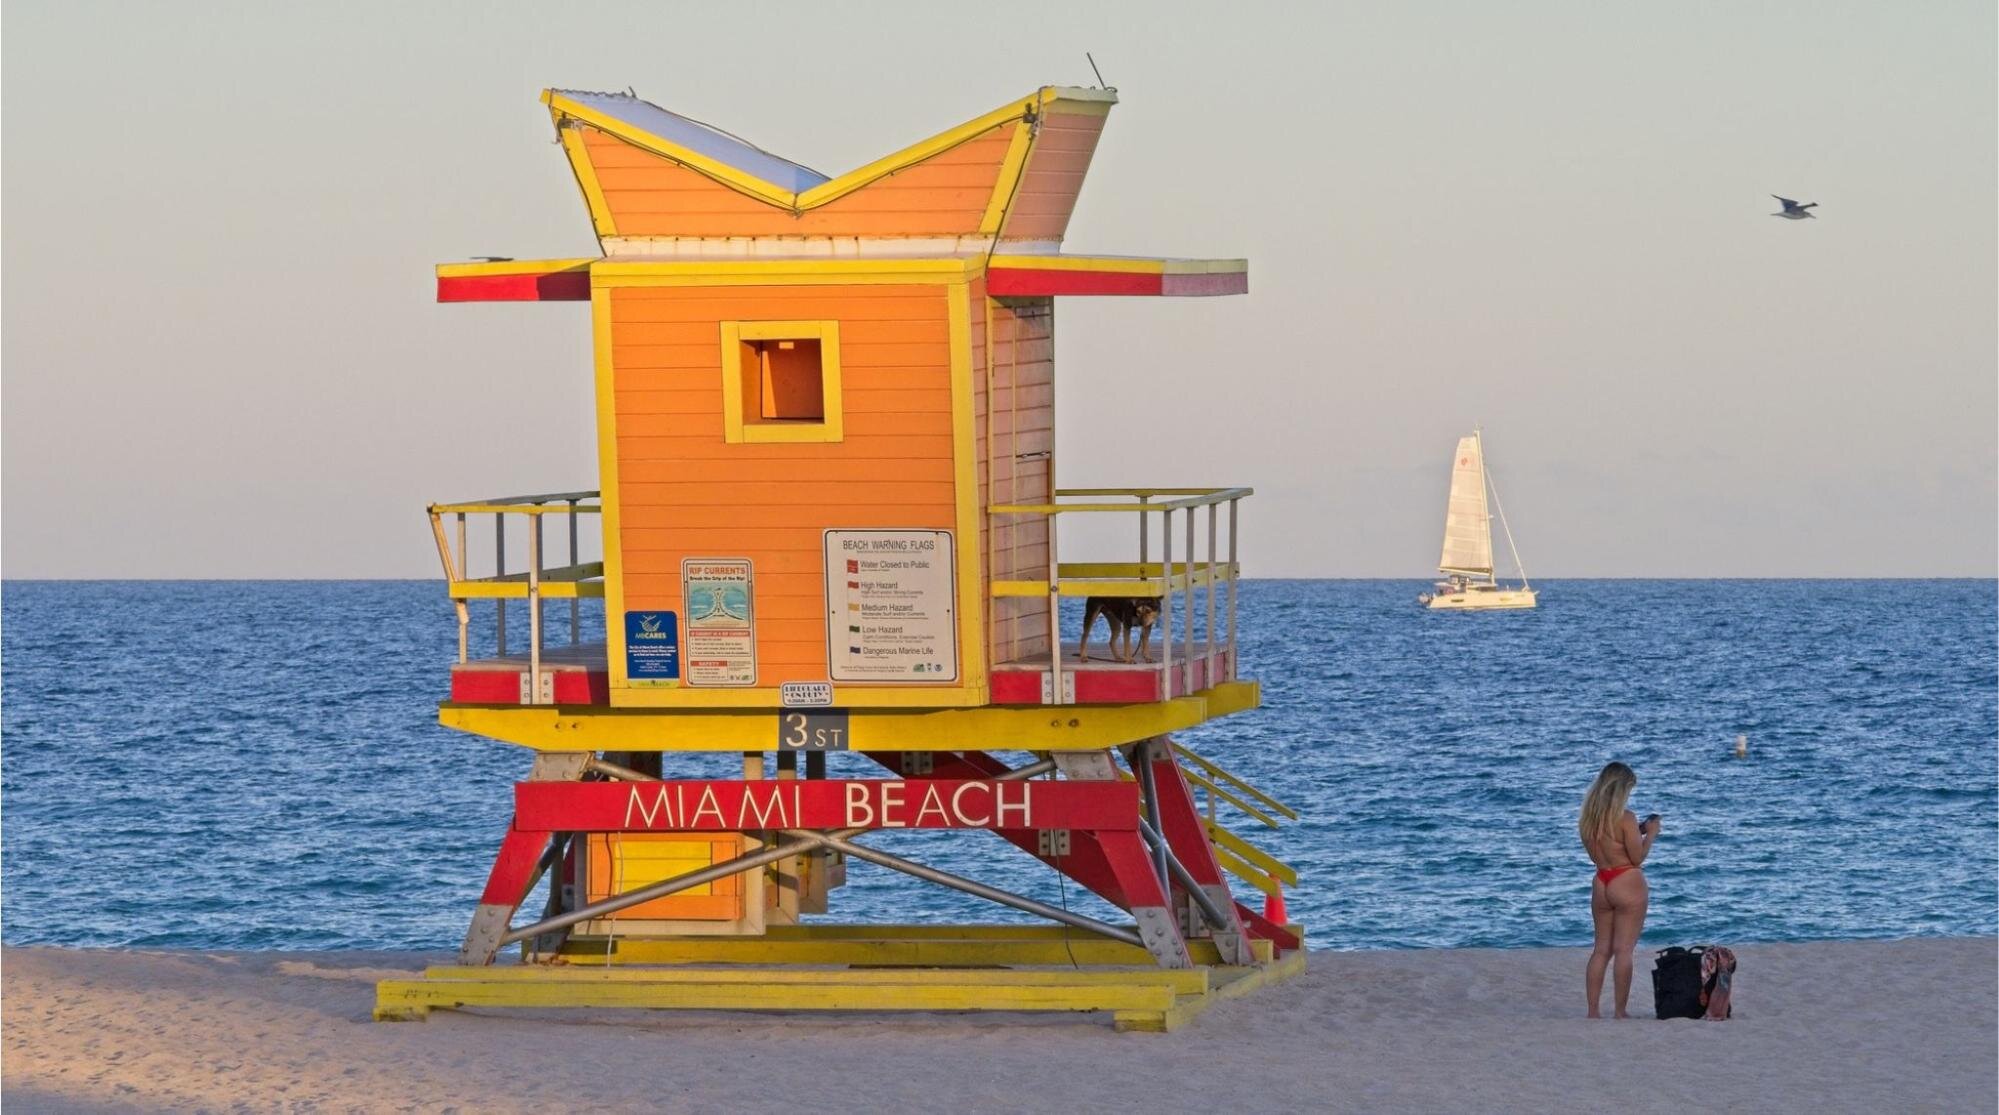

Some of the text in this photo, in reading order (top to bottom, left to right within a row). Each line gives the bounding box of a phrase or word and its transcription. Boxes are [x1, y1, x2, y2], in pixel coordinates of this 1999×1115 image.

[843, 539, 935, 550] BEACH WARNING FLAGS
[861, 560, 878, 568] Water
[880, 560, 902, 568] Closed
[911, 560, 930, 568] Public
[861, 582, 875, 590] High
[863, 647, 897, 656] Dangerous
[786, 713, 843, 747] 3 ST
[625, 781, 1031, 829] MIAMI BEACH
